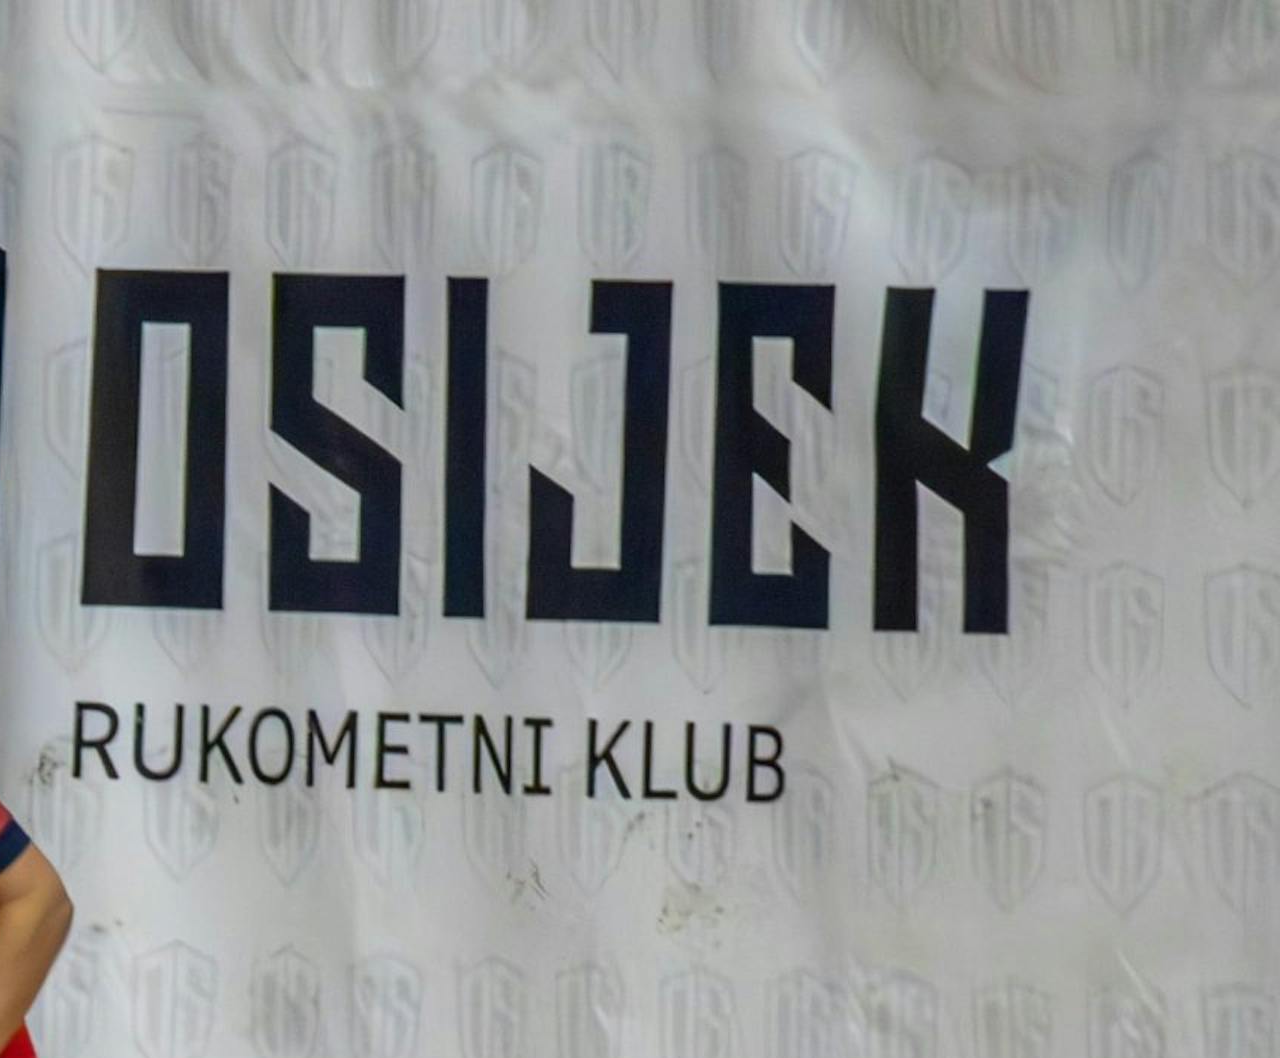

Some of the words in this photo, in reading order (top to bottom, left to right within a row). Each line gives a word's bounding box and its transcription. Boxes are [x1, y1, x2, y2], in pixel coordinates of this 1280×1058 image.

[80, 267, 1030, 635] OSIJEK
[70, 700, 554, 797] RUKOMETNI
[585, 717, 786, 803] KLUB
